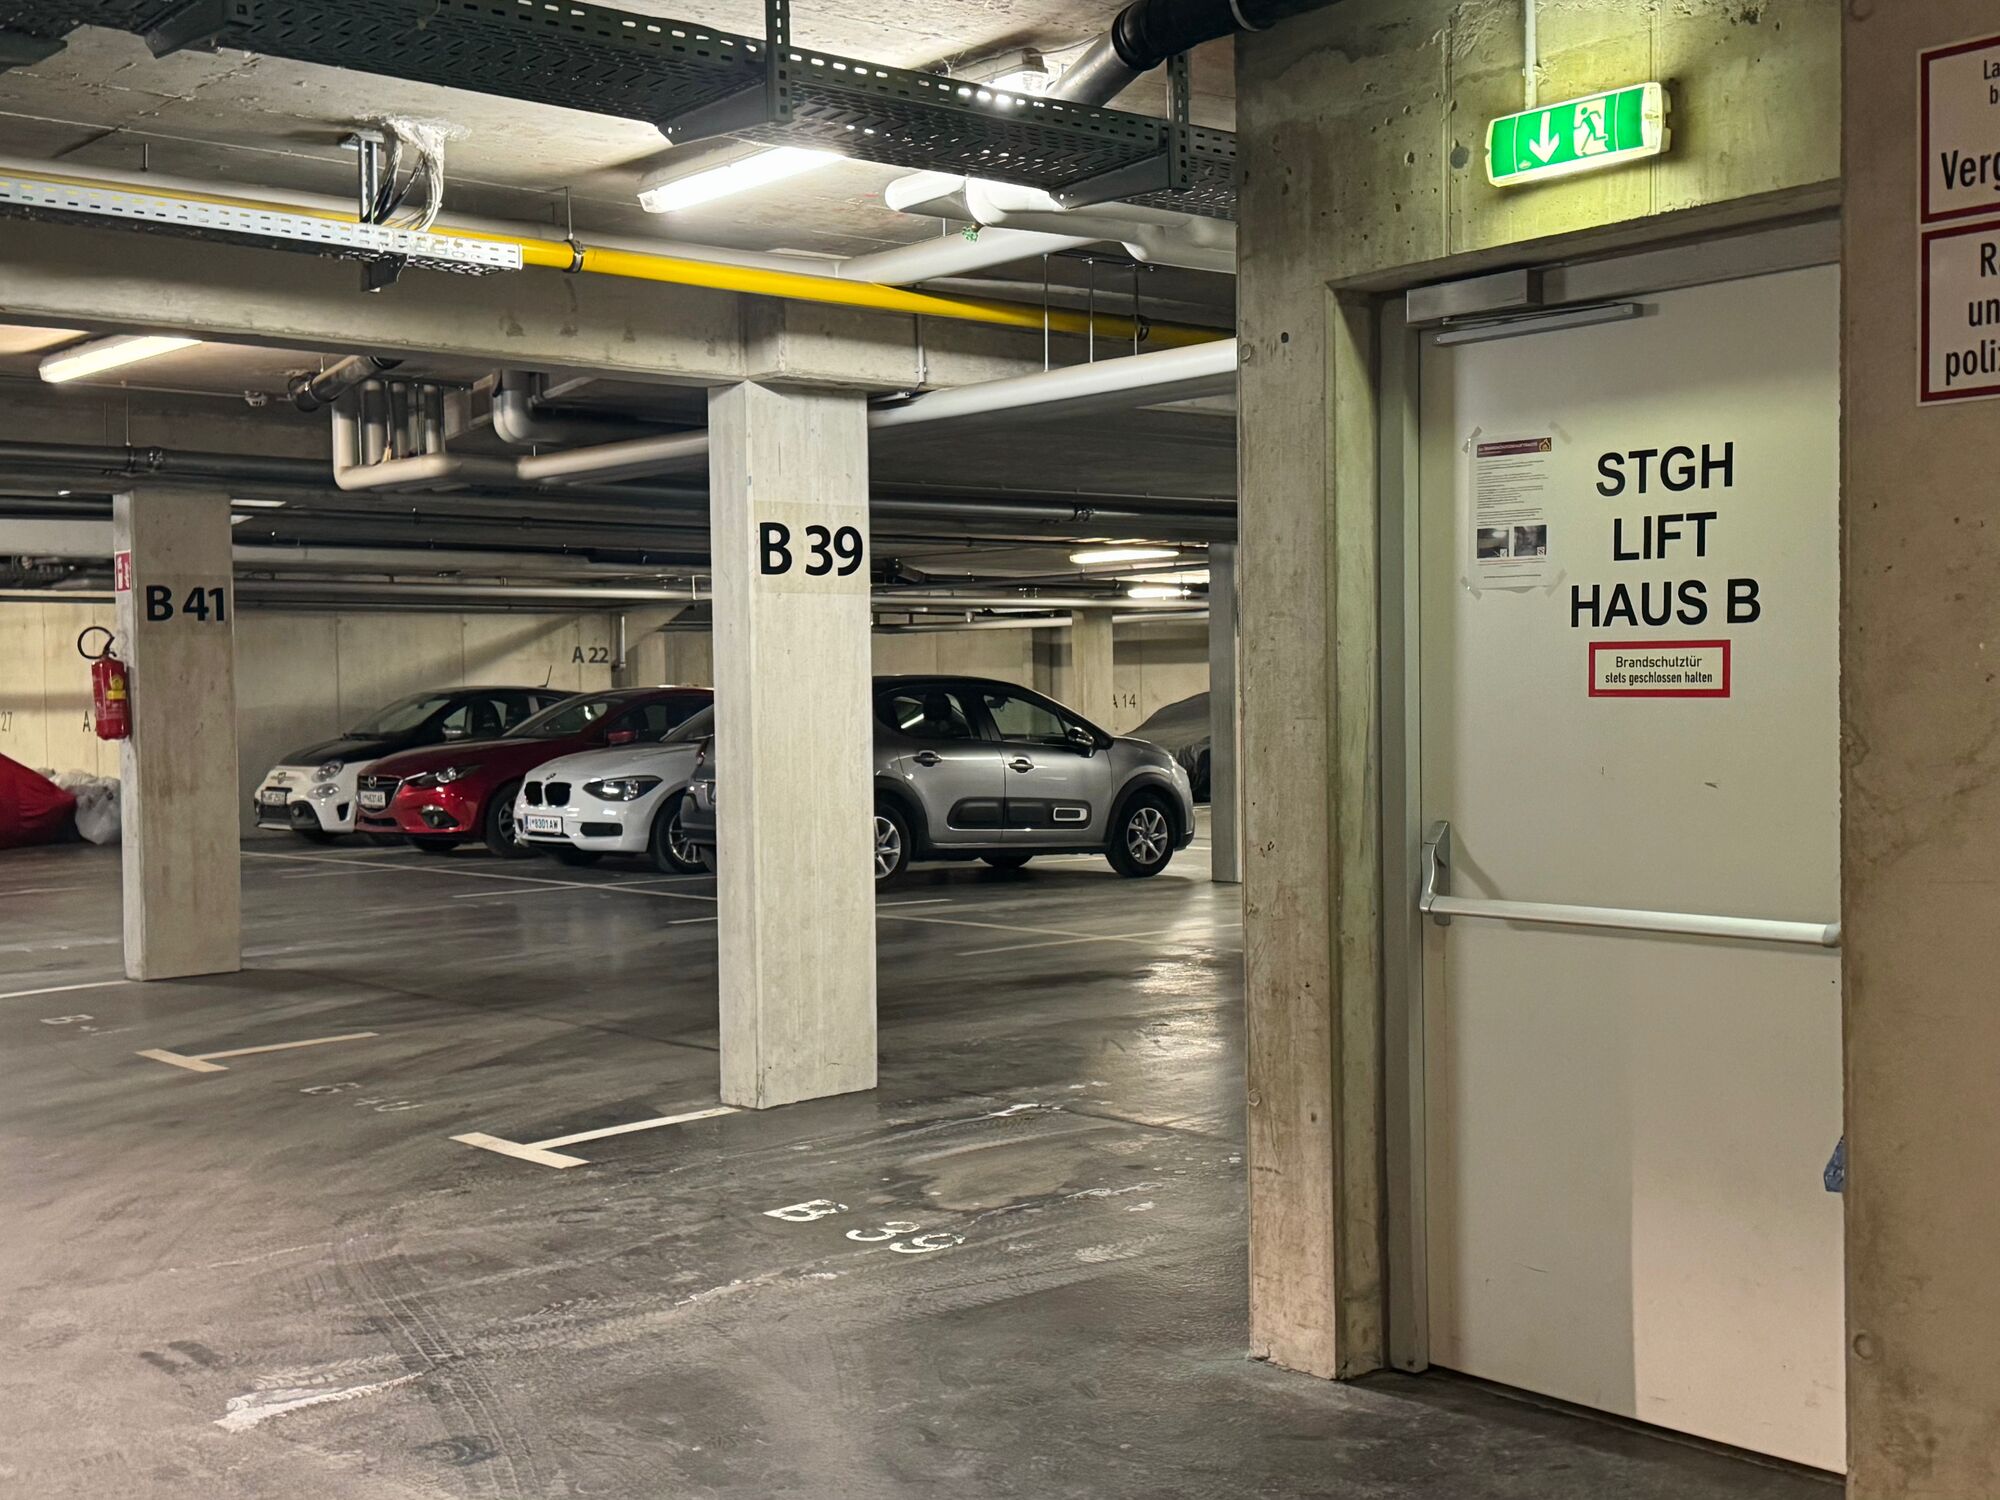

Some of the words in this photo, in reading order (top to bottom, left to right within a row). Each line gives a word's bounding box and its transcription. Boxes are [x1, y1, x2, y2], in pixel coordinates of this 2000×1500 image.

[1981, 242, 2000, 277] R
[1946, 339, 2000, 386] poli
[1596, 441, 1733, 497] STGH
[759, 522, 792, 575] B
[805, 525, 863, 576] 39
[1613, 511, 1717, 561] LIFT
[146, 585, 174, 621] B
[182, 587, 224, 621] 41
[1571, 580, 1708, 627] HAUS
[1727, 578, 1761, 624] B
[572, 646, 584, 663] A
[589, 647, 608, 663] 22
[1615, 656, 1702, 668] Brandschutztür
[1605, 672, 1627, 683] stets
[1629, 671, 1682, 686] geschlossen
[1684, 671, 1713, 683] halten
[1122, 693, 1136, 708] 14
[1, 711, 12, 732] 27
[83, 710, 91, 732] A
[763, 1199, 849, 1222] B
[846, 1221, 966, 1253] 39
